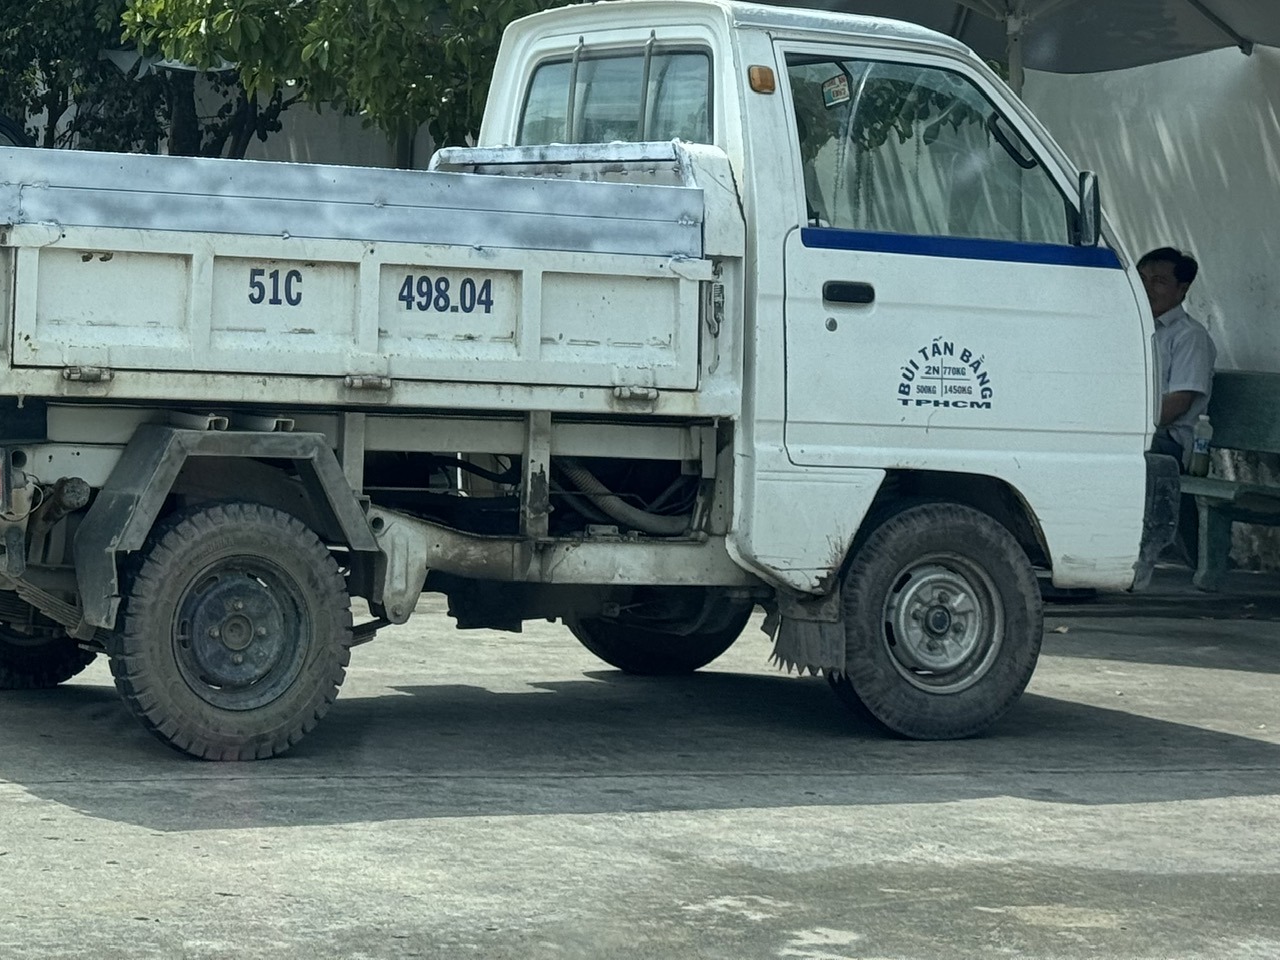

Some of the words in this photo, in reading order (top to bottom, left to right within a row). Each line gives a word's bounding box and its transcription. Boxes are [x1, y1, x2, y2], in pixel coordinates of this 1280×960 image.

[248, 268, 303, 306] 51C
[398, 274, 494, 314] 498.04
[898, 359, 920, 396] BÙI
[918, 336, 954, 362] TẤN
[924, 365, 940, 376] 2N
[942, 366, 967, 376] 770KG
[916, 384, 937, 394] 500KG
[943, 385, 972, 395] 1450KG
[897, 398, 992, 409] TPHCM
